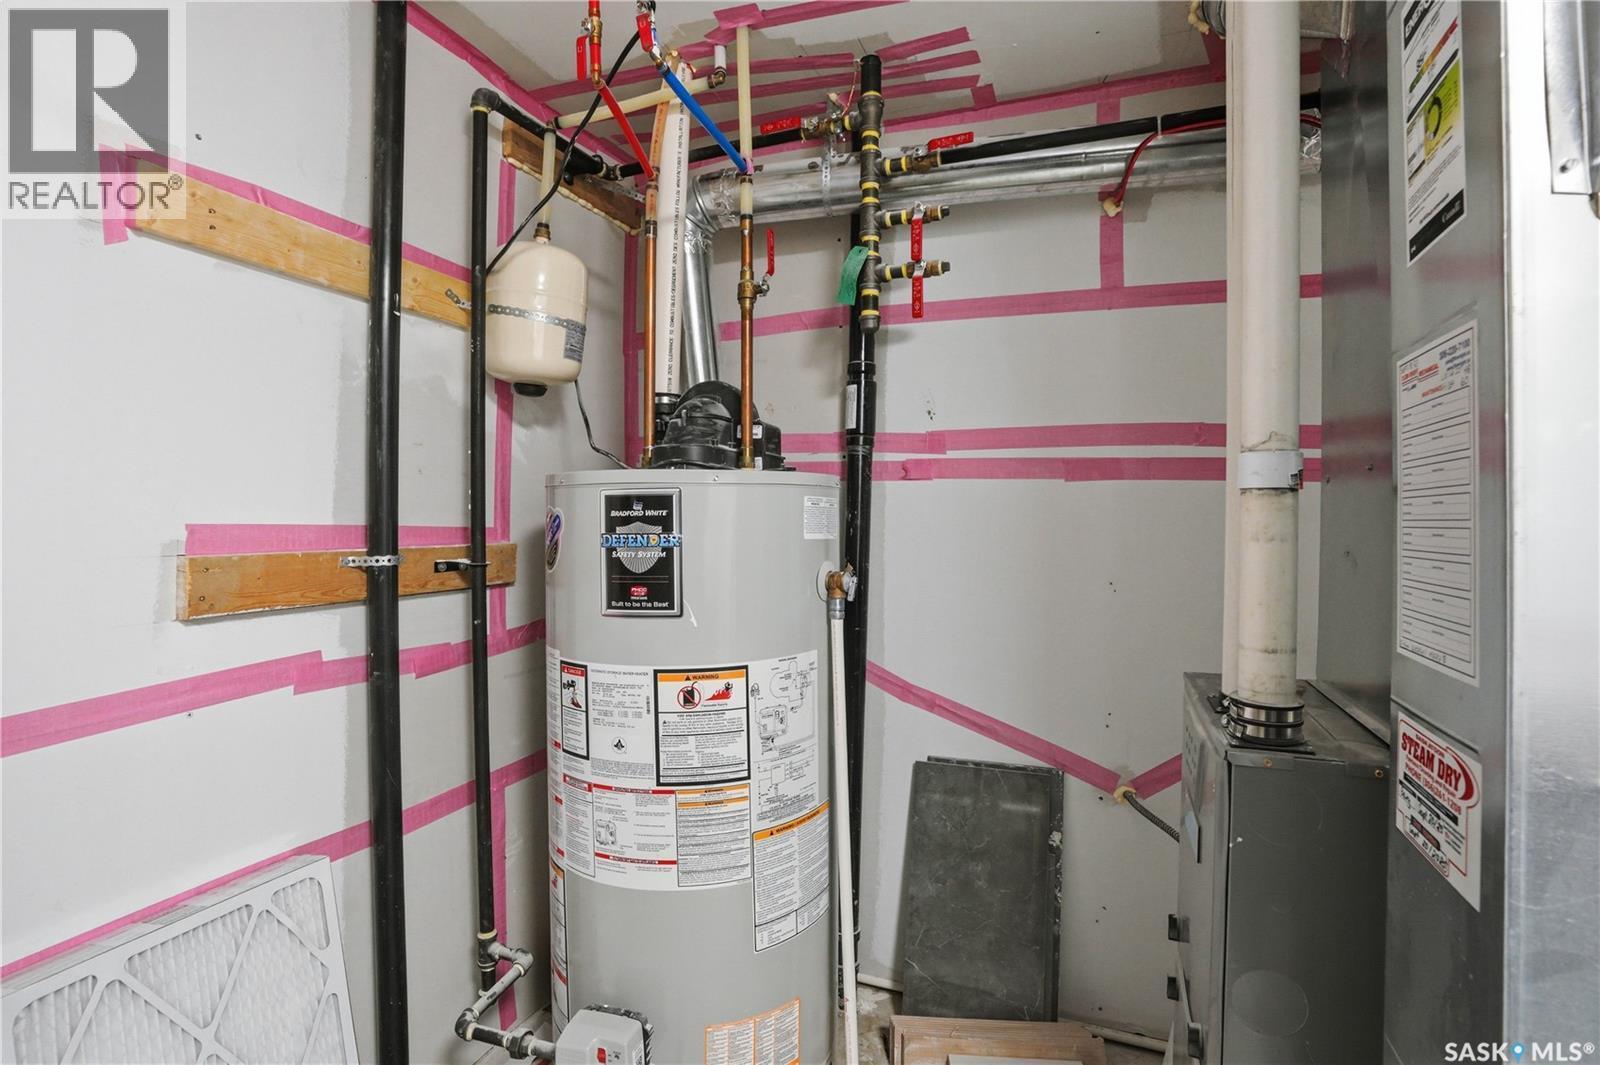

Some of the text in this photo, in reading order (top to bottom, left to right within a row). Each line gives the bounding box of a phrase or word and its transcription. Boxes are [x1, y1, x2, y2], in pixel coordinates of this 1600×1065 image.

[645, 509, 668, 517] WHITE
[601, 533, 681, 548] DEFENDER
[1401, 732, 1461, 792] STEAM DRY
